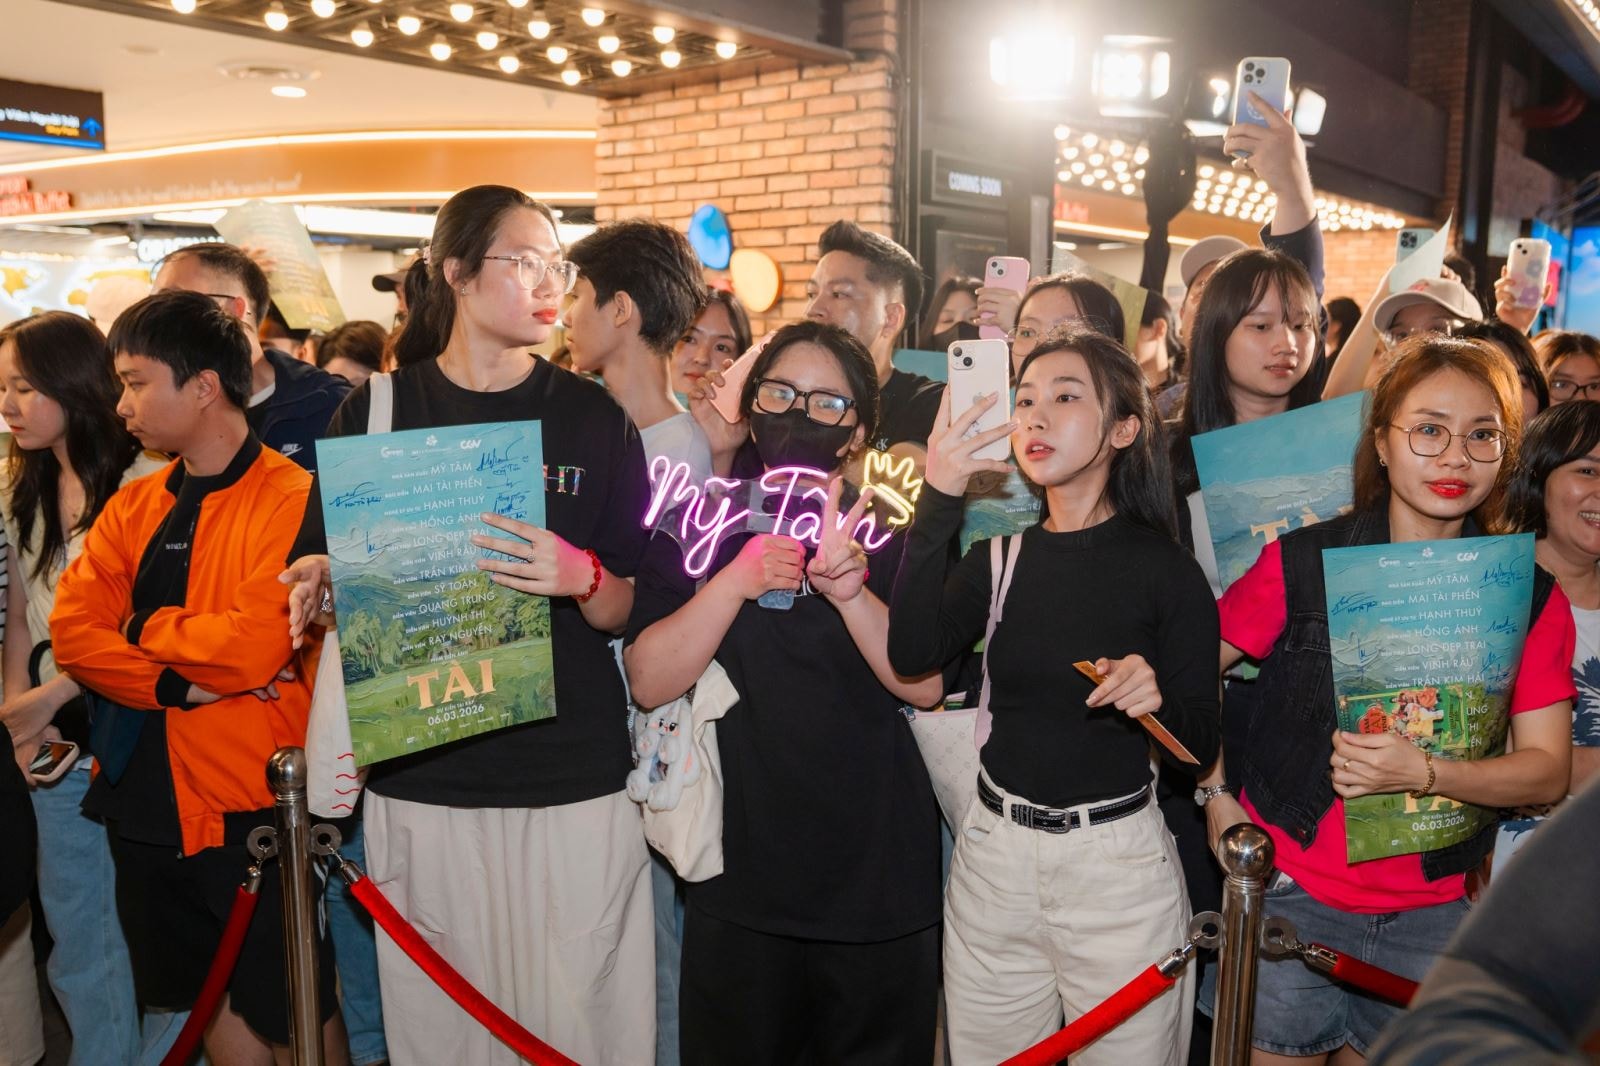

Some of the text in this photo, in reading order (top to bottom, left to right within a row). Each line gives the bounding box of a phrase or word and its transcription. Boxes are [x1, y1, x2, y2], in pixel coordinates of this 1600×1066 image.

[460, 438, 482, 451] CGV
[431, 463, 447, 476] MỸ
[449, 460, 473, 473] TÂM
[412, 483, 433, 495] MAI
[436, 479, 451, 492] TÀI
[423, 498, 455, 513] HẠNH
[420, 513, 454, 529] HỒNG
[643, 455, 750, 576] Mỹ
[413, 532, 444, 547] LONG
[1456, 551, 1480, 562] CGV
[419, 564, 446, 580] TRẦN
[449, 565, 468, 576] KIM
[1426, 574, 1443, 586] MỸ
[1447, 573, 1469, 585] TÂM
[418, 598, 458, 614] QUANG
[461, 592, 496, 606] TRUNG
[1408, 594, 1429, 604] MAI
[1432, 591, 1448, 602] TÀI
[432, 613, 468, 628] HUỲNH
[1418, 610, 1451, 623] HẠNH
[428, 633, 451, 646] RAY
[449, 622, 493, 641] NGUYỄN
[1415, 624, 1451, 638] HỒNG
[1407, 643, 1439, 655] LONG
[1464, 639, 1487, 650] TRAI
[407, 658, 497, 710] TÀI
[1411, 673, 1440, 688] TRẦN
[1443, 675, 1464, 686] KIM
[427, 704, 486, 727] 06.03.2026
[1411, 814, 1466, 832] 06.03.2026
